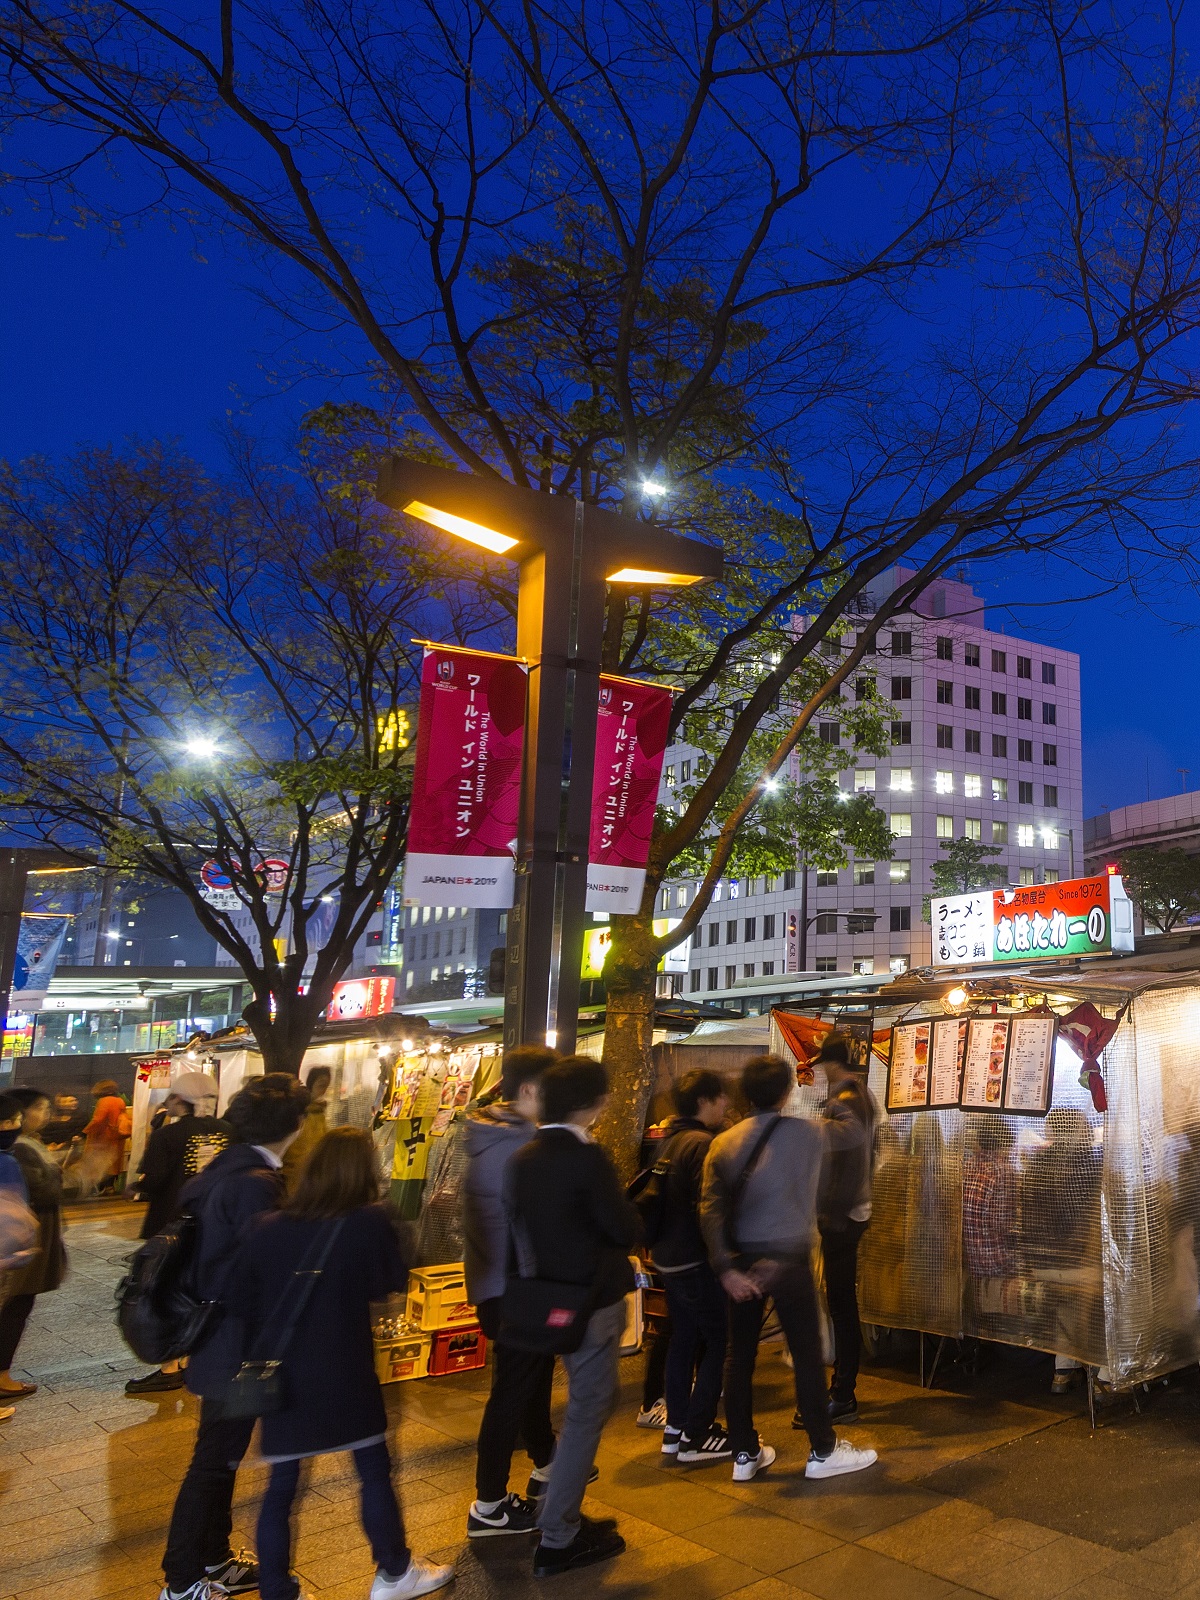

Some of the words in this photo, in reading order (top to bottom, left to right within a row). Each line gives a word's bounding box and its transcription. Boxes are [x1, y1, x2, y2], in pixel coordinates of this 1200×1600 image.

[464, 674, 480, 732] ワールド
[481, 712, 490, 728] The
[615, 701, 633, 753] ワールド
[461, 742, 476, 768] イン
[478, 731, 489, 760] World
[629, 736, 637, 750] The
[477, 763, 487, 771] in
[609, 762, 622, 786] イン
[624, 753, 635, 781] World
[476, 774, 486, 802] Union
[622, 781, 630, 789] in
[456, 779, 473, 837] ユニオン
[618, 792, 629, 817] Union
[600, 796, 617, 848] ユニオン
[939, 900, 982, 921] ラーメン
